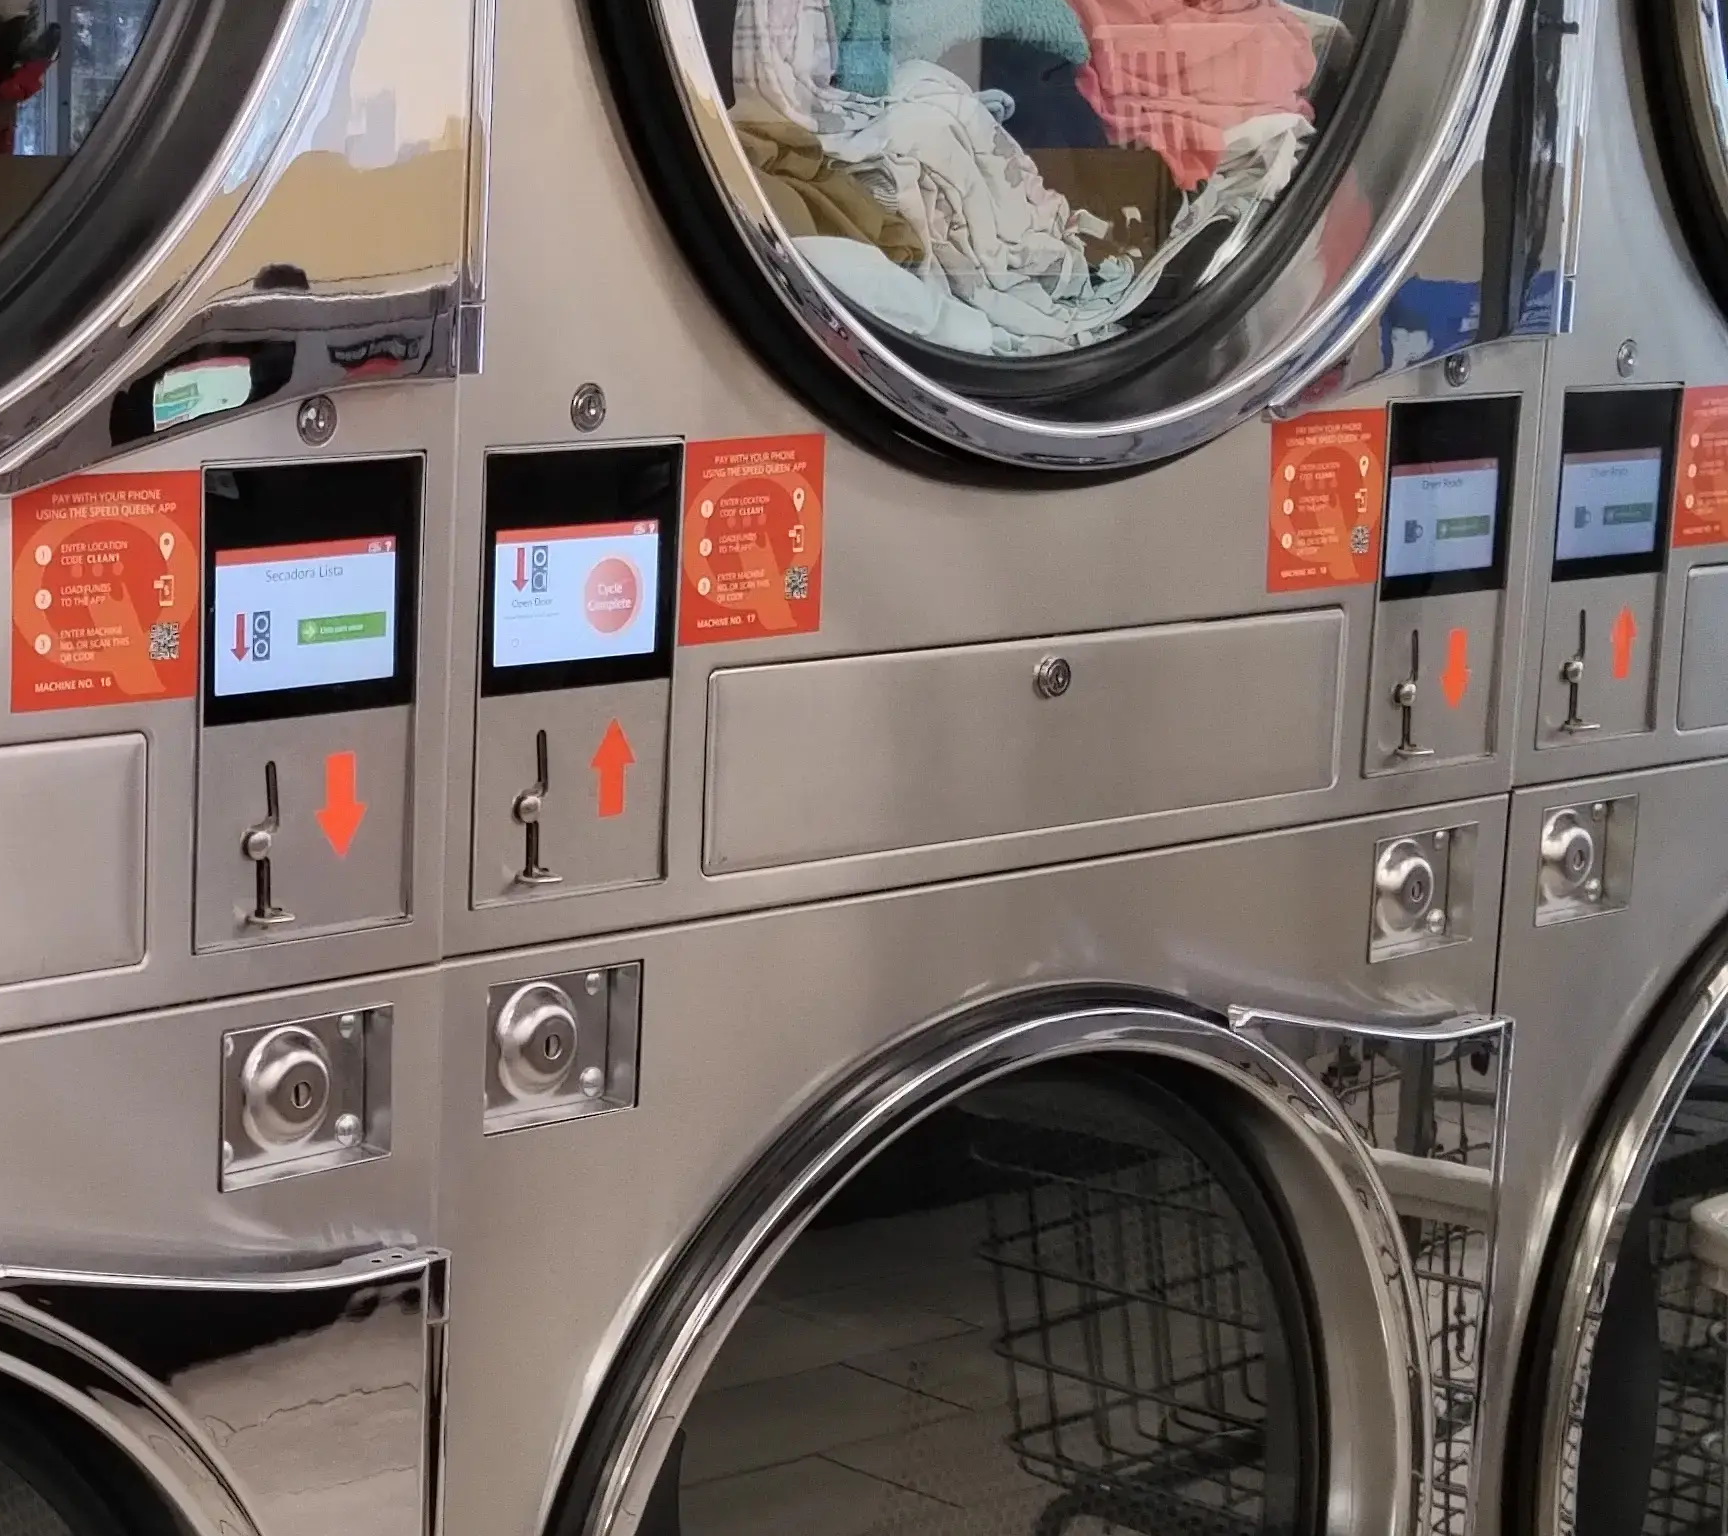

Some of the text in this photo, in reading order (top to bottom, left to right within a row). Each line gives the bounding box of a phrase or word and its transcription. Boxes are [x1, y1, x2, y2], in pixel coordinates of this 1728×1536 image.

[52, 489, 161, 505] PAY WITH YOUR PHONE
[36, 509, 67, 520] USING
[158, 503, 177, 513] APP
[265, 565, 343, 582] Secadora Lista
[34, 680, 76, 693] MACHINE
[100, 677, 111, 687] 16
